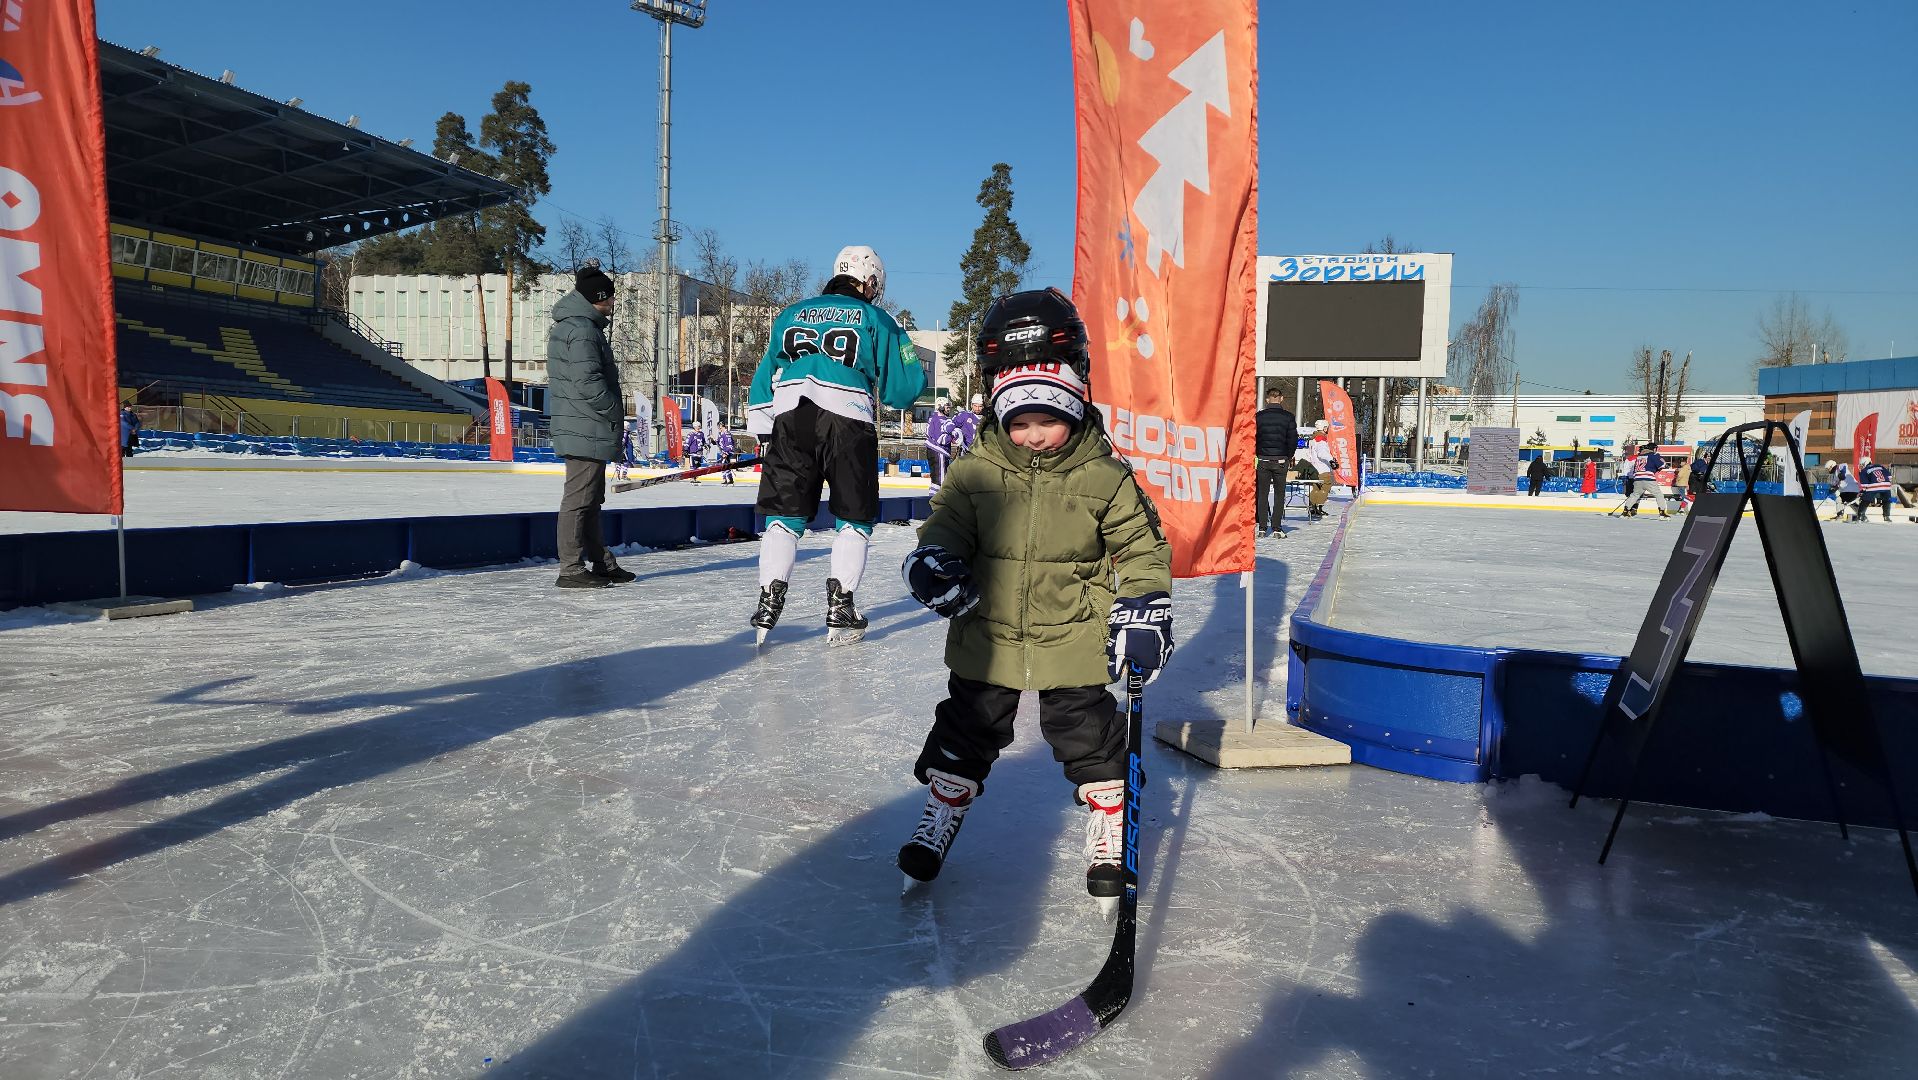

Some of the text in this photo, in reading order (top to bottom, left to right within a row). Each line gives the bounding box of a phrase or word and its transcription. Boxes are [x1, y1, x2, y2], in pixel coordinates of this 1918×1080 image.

[839, 261, 849, 272] 69
[1302, 256, 1399, 264] СТАДИОН
[1269, 257, 1425, 284] Зоркий
[1004, 328, 1045, 342] CCM
[782, 326, 860, 369] 69
[934, 779, 965, 794] CCM
[1126, 752, 1141, 875] FISCHER
